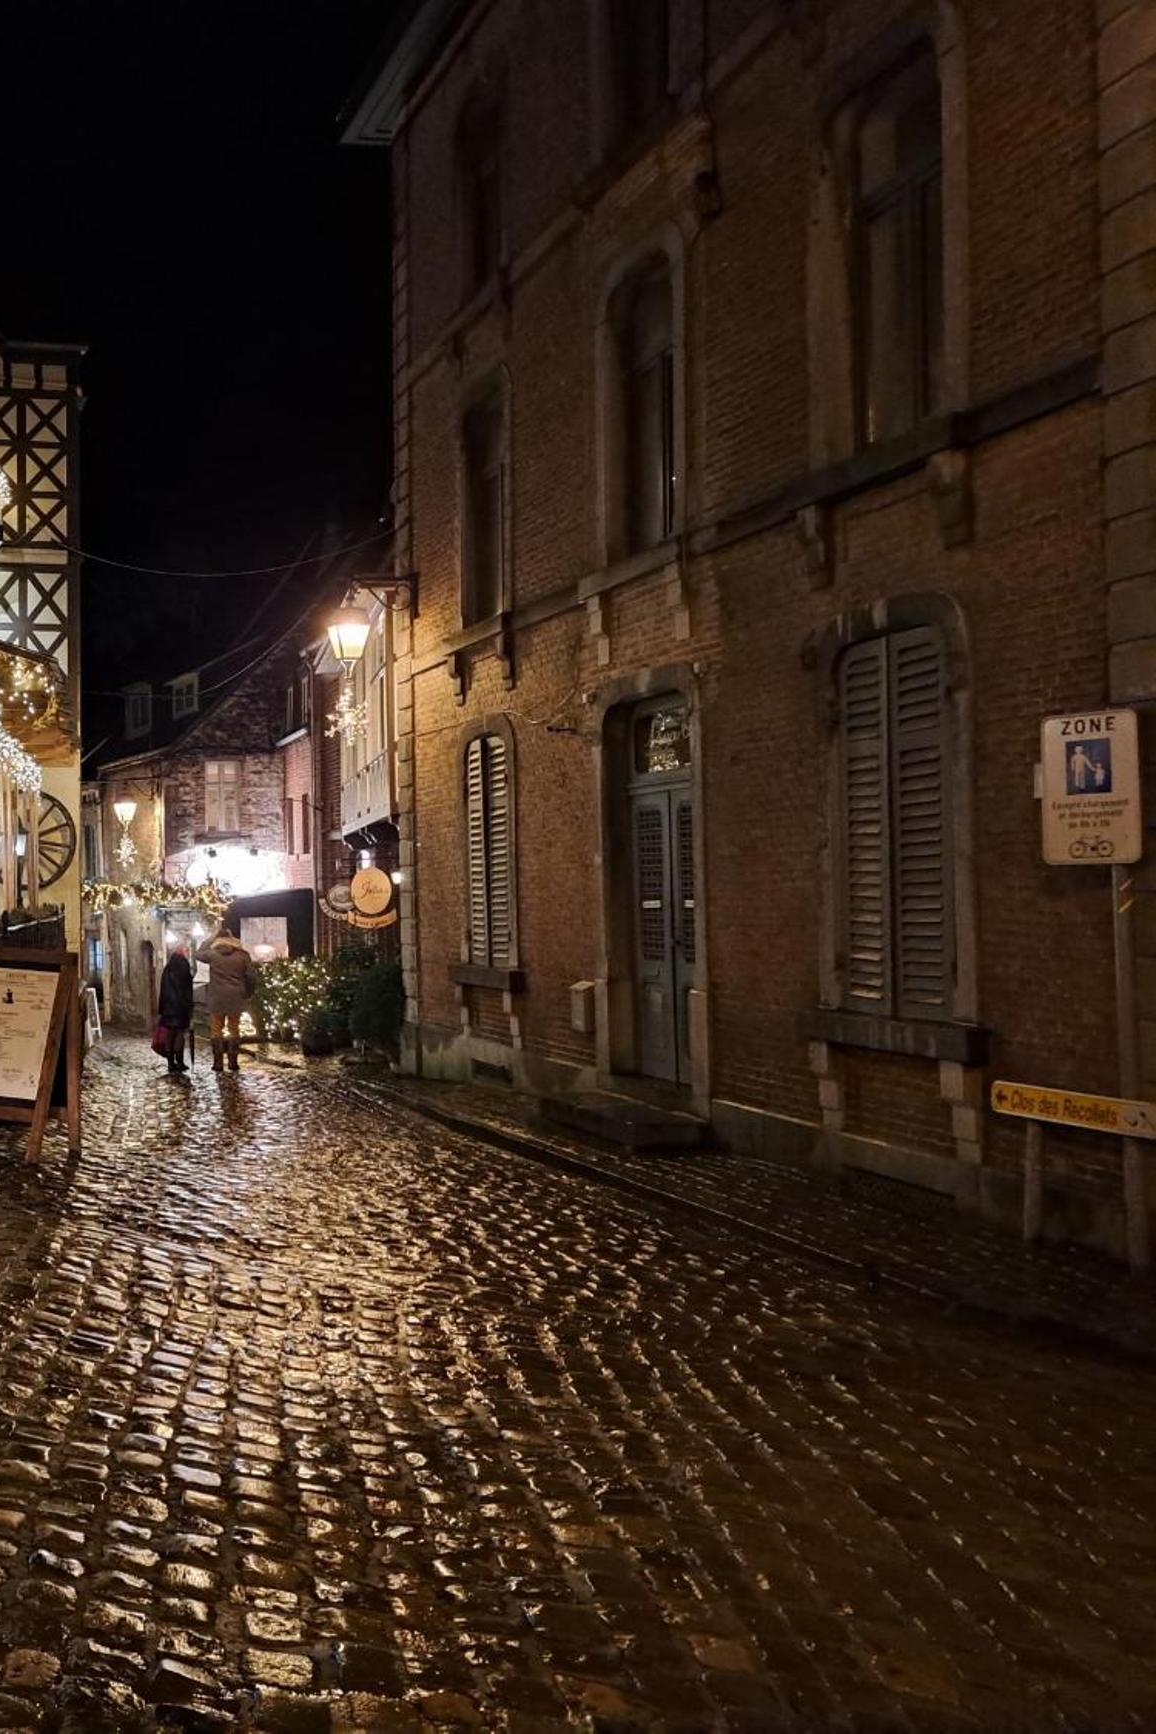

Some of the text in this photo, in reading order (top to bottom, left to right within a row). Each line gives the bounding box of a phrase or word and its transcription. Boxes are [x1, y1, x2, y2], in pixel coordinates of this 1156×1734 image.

[1060, 716, 1117, 736] ZONE
[1011, 1089, 1035, 1112] Clos
[1037, 1094, 1058, 1116] des
